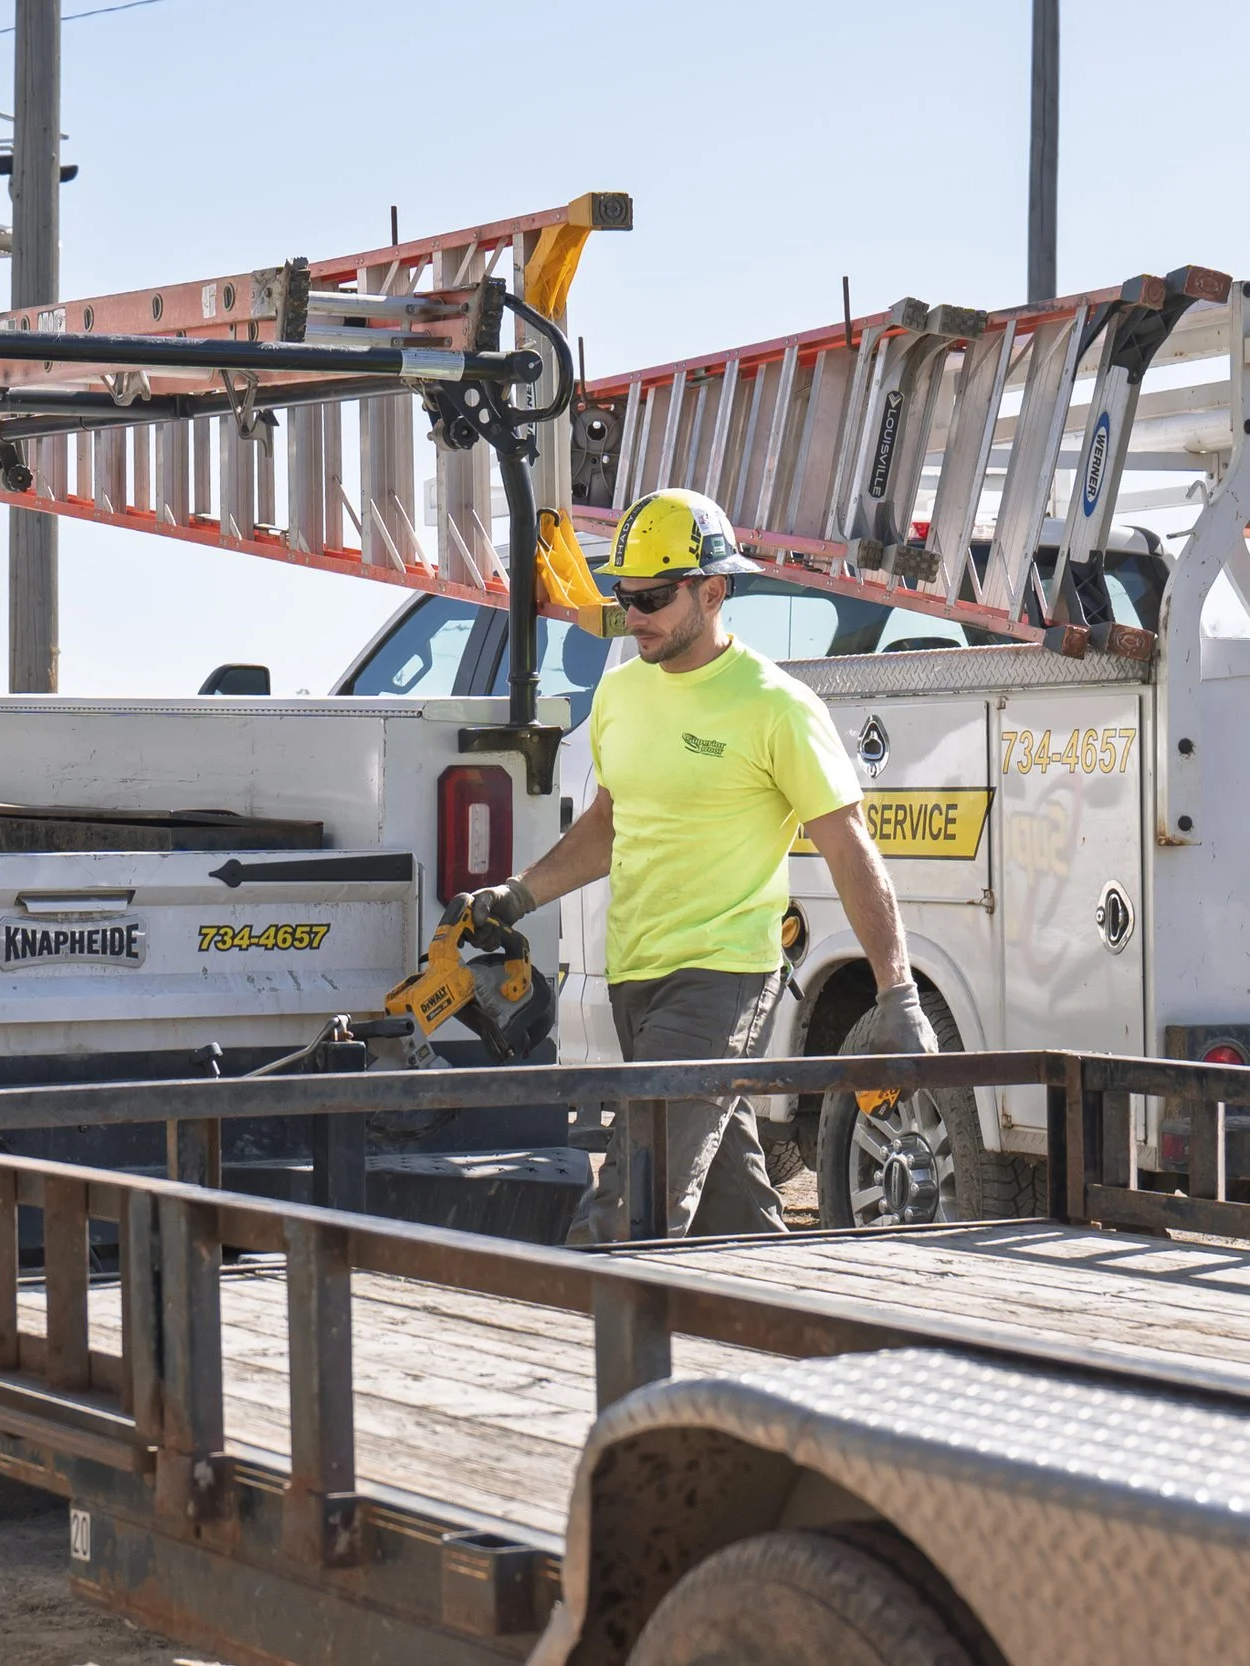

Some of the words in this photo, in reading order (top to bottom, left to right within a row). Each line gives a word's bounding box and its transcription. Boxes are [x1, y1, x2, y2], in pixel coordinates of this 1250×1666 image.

[872, 408, 897, 497] LOUISVILLE
[1087, 433, 1106, 498] WERNER
[1000, 727, 1137, 775] 734-4657
[867, 803, 958, 841] SERVICE
[5, 923, 139, 962] KNAPHEIDE
[198, 923, 331, 951] 734-4657
[72, 1512, 89, 1556] 20
